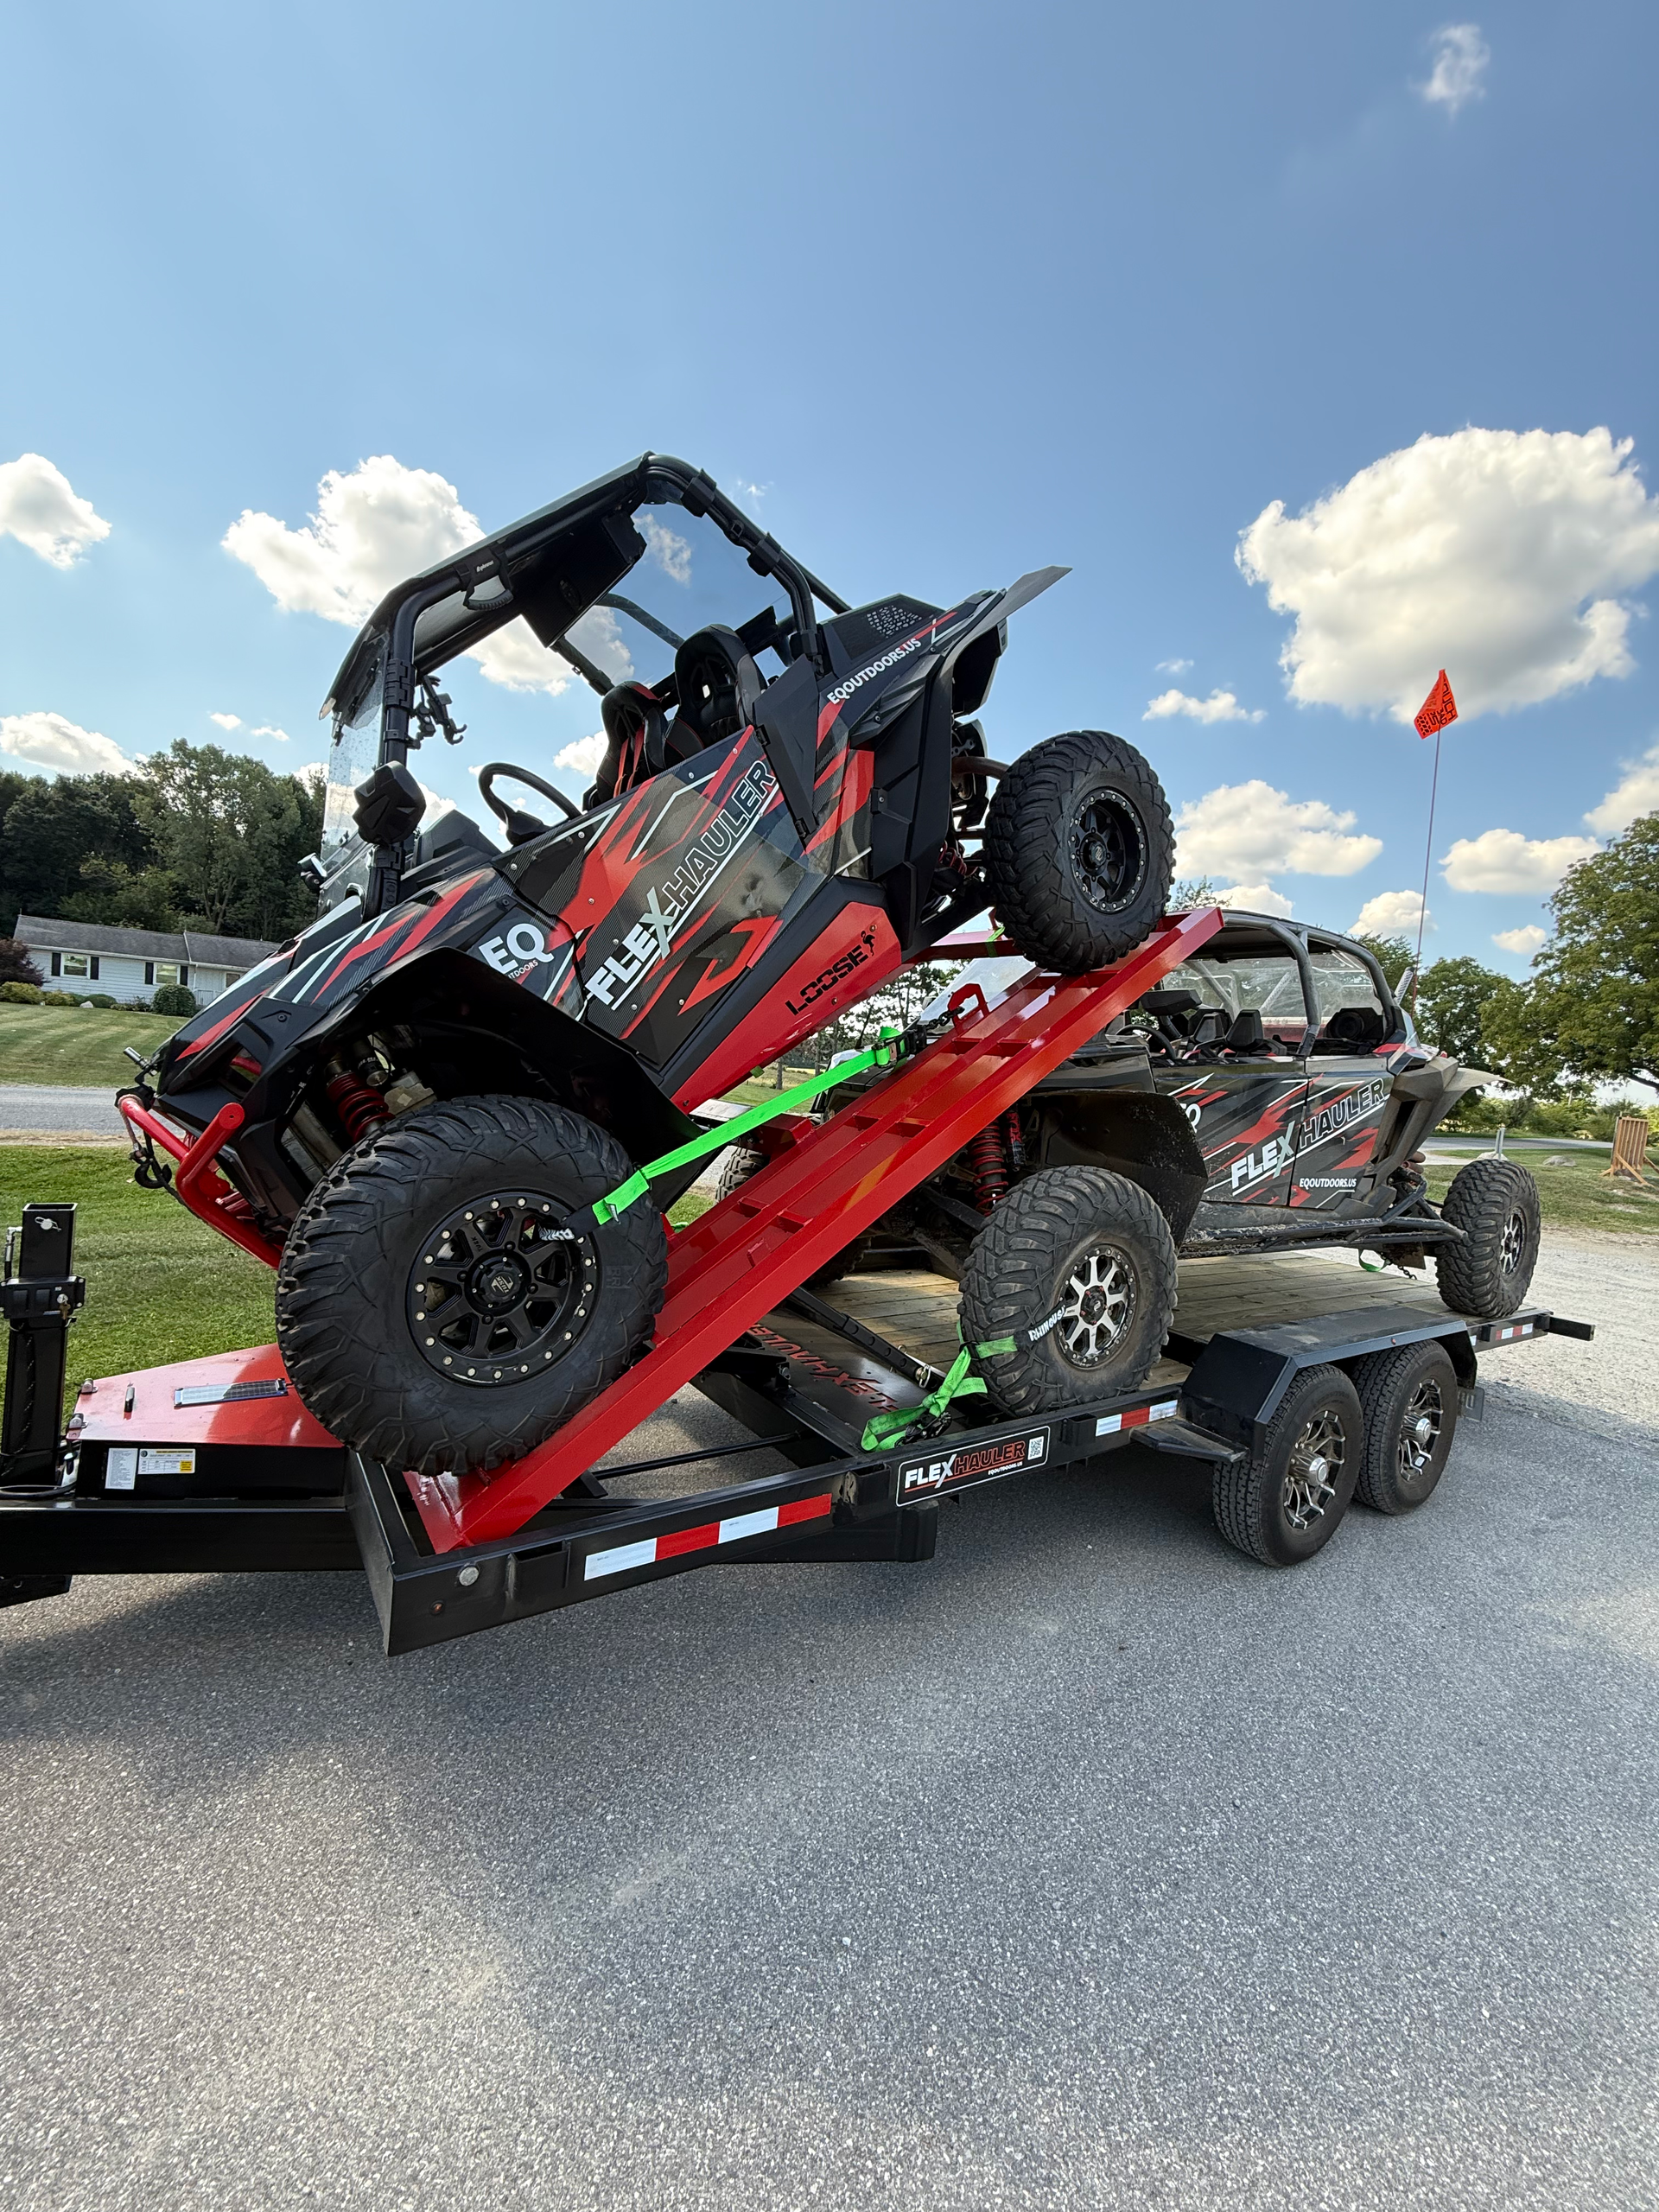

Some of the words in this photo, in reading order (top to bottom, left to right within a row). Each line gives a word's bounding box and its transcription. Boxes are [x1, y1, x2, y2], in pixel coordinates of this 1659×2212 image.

[826, 638, 922, 705] EQOUTDOORS.US
[585, 887, 675, 1005] FLEX
[662, 760, 776, 910] HAULER
[478, 923, 555, 975] EQ
[785, 944, 869, 1016] LOOSE
[1180, 1103, 1201, 1134] Q
[1231, 1121, 1295, 1189] FLEX
[1300, 1078, 1385, 1150] HAULER
[1299, 1178, 1357, 1190] EQOUTDOORS.US
[747, 1323, 839, 1374] HAULE
[904, 1453, 957, 1489] FLEX
[954, 1440, 1026, 1475] HAULER
